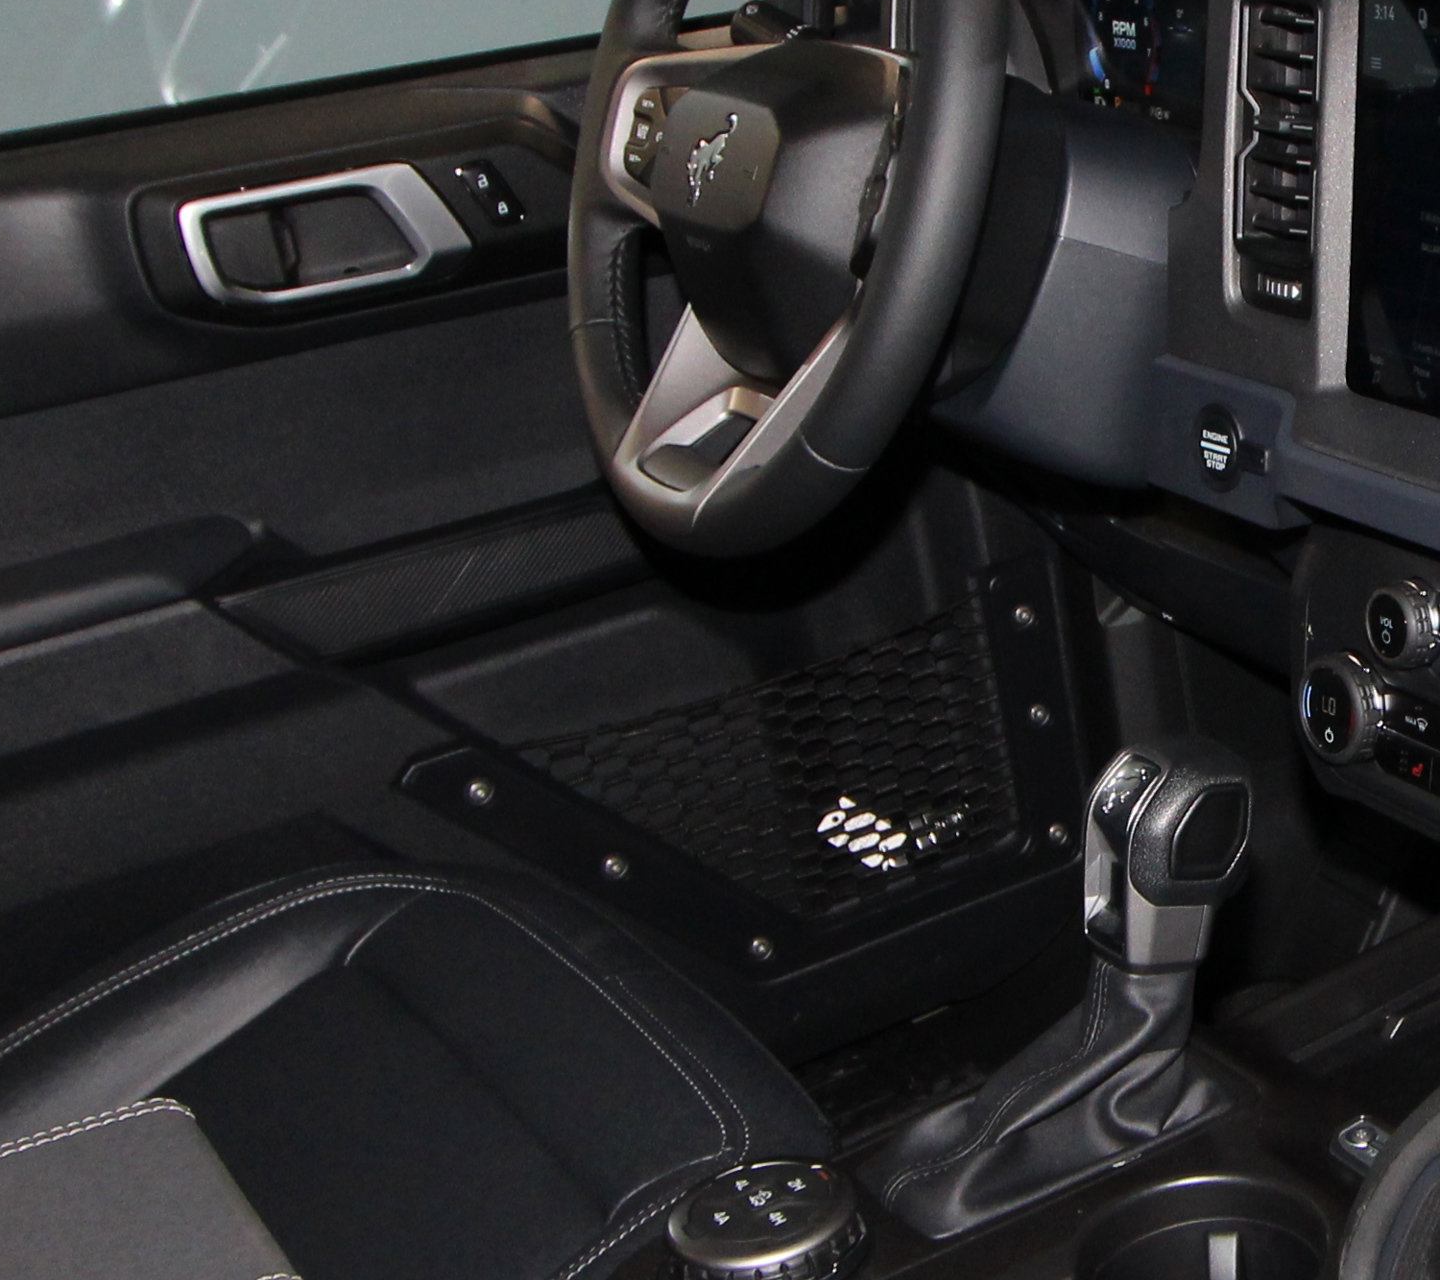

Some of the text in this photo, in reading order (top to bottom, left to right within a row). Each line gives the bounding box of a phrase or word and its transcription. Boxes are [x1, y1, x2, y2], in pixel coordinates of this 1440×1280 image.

[1374, 4, 1395, 21] 3:14
[1112, 20, 1136, 37] RPM
[1114, 38, 1136, 50] X1000
[1203, 429, 1229, 445] ENGINE
[1203, 450, 1228, 463] START
[1206, 459, 1226, 471] STOP
[1380, 616, 1393, 629] VOL
[1322, 695, 1336, 716] LO
